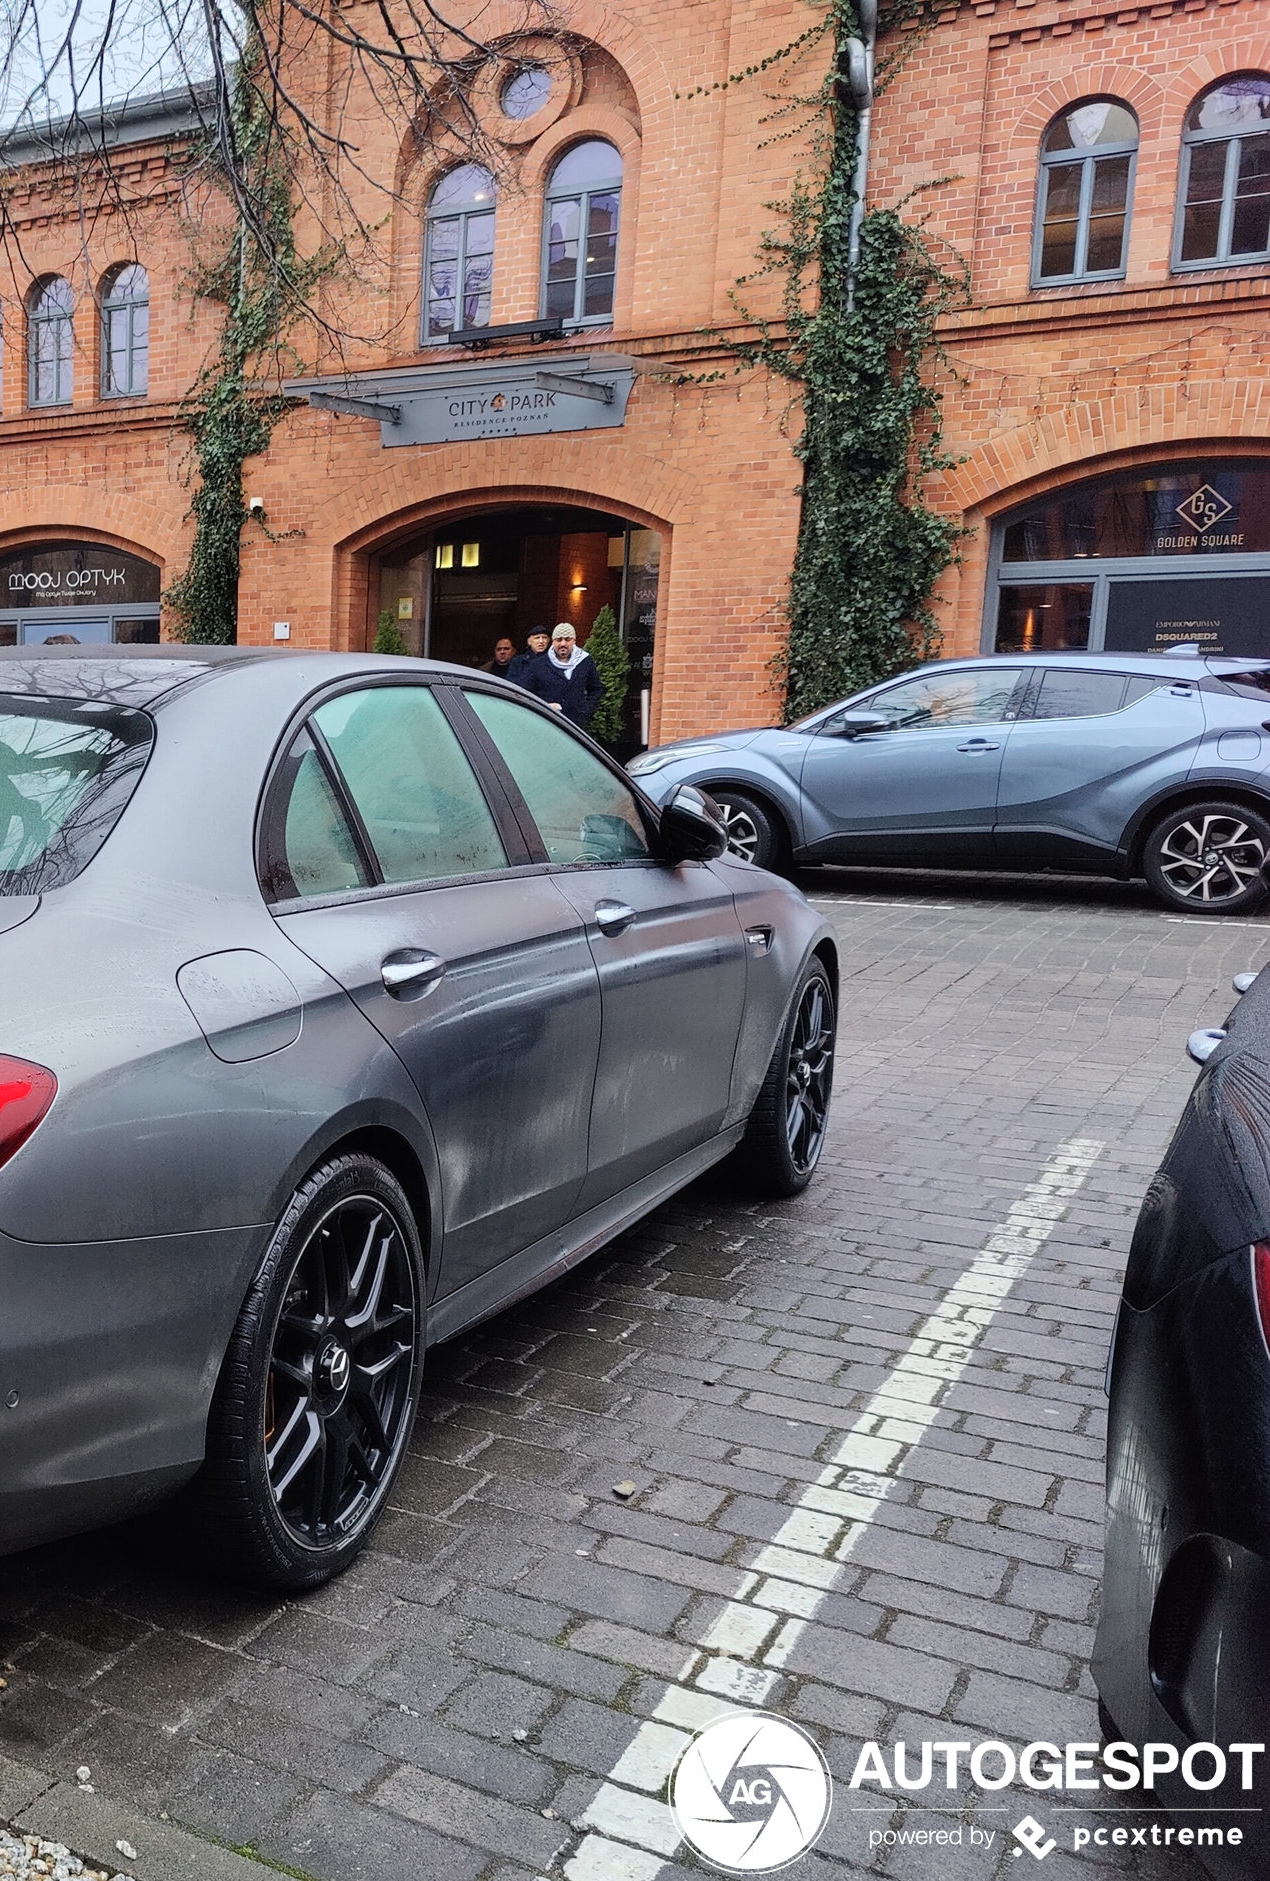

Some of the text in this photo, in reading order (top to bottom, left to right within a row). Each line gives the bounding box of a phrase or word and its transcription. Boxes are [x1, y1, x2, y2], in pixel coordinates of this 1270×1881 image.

[449, 391, 557, 416] CITY PARK
[454, 412, 550, 428] RESIDENCE POZNAŃ
[1157, 533, 1245, 548] GOLDEN SQUARE
[66, 568, 125, 587] OPTYK
[1155, 632, 1218, 641] DSQUARED2
